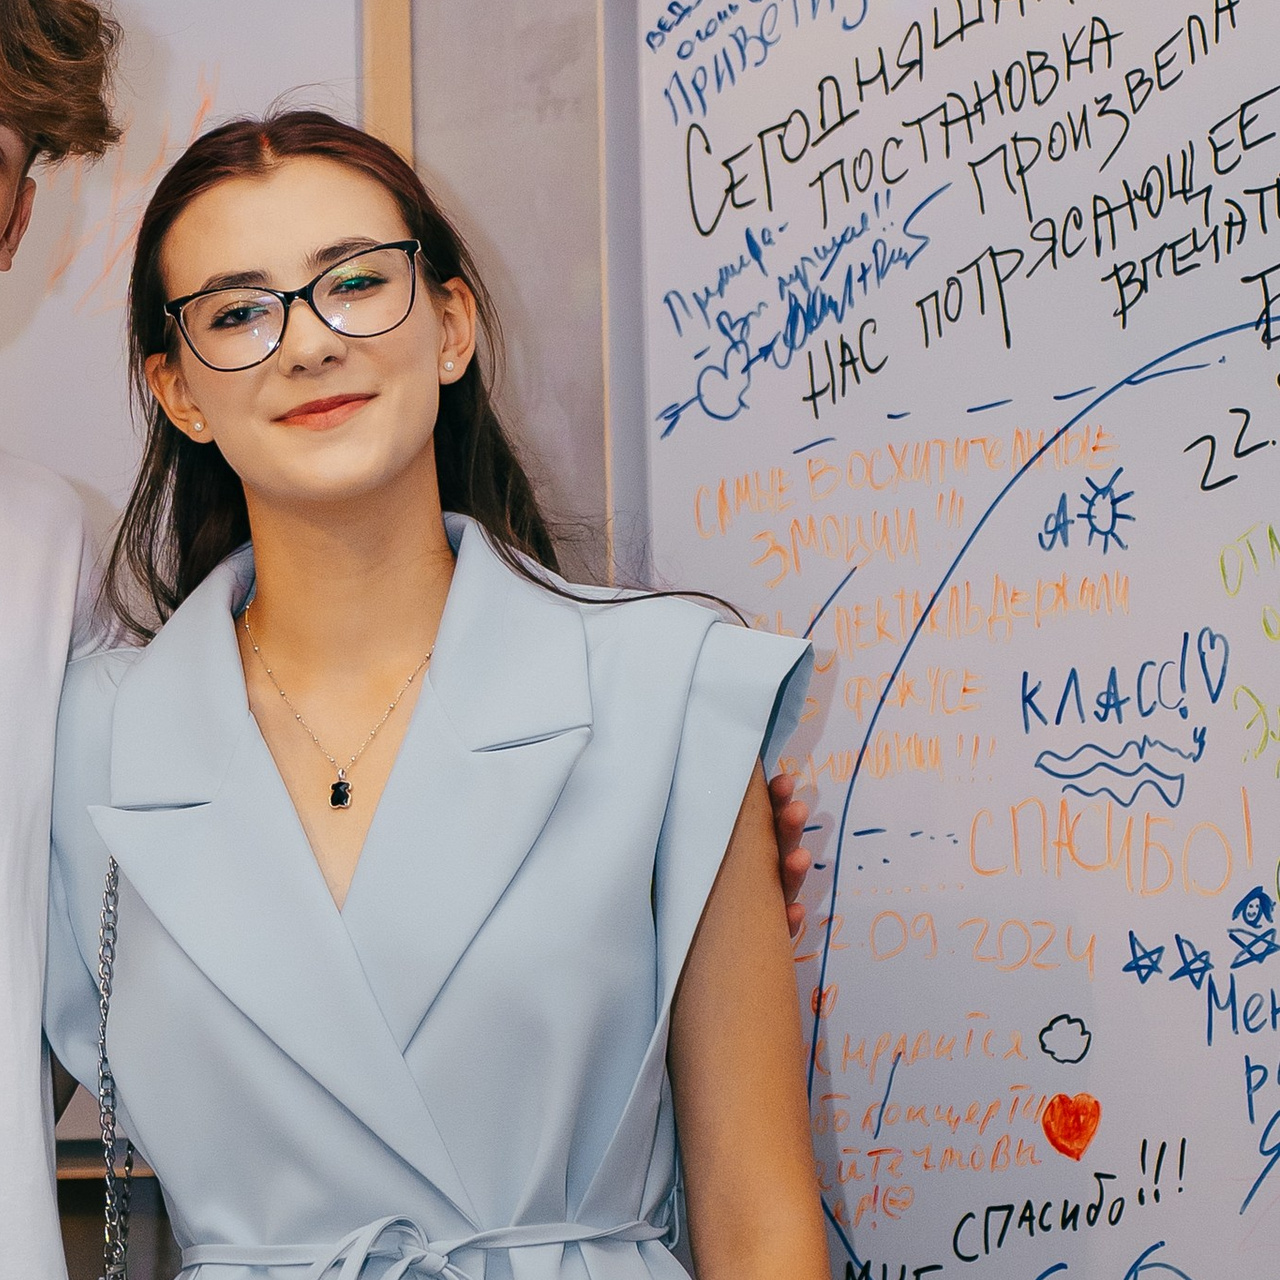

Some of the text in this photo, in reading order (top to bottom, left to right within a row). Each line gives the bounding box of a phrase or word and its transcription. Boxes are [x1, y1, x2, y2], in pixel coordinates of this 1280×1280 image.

[809, 15, 1124, 229] ПОСТАНОВКА
[802, 318, 890, 420] НАС
[915, 85, 1280, 350] ПОТРЯСАЮЩЕЕ
[1100, 175, 1280, 331] ВПЕЧАТ
[1022, 632, 1190, 735] КЛАСС!
[970, 786, 1254, 897] СПАСИБО!
